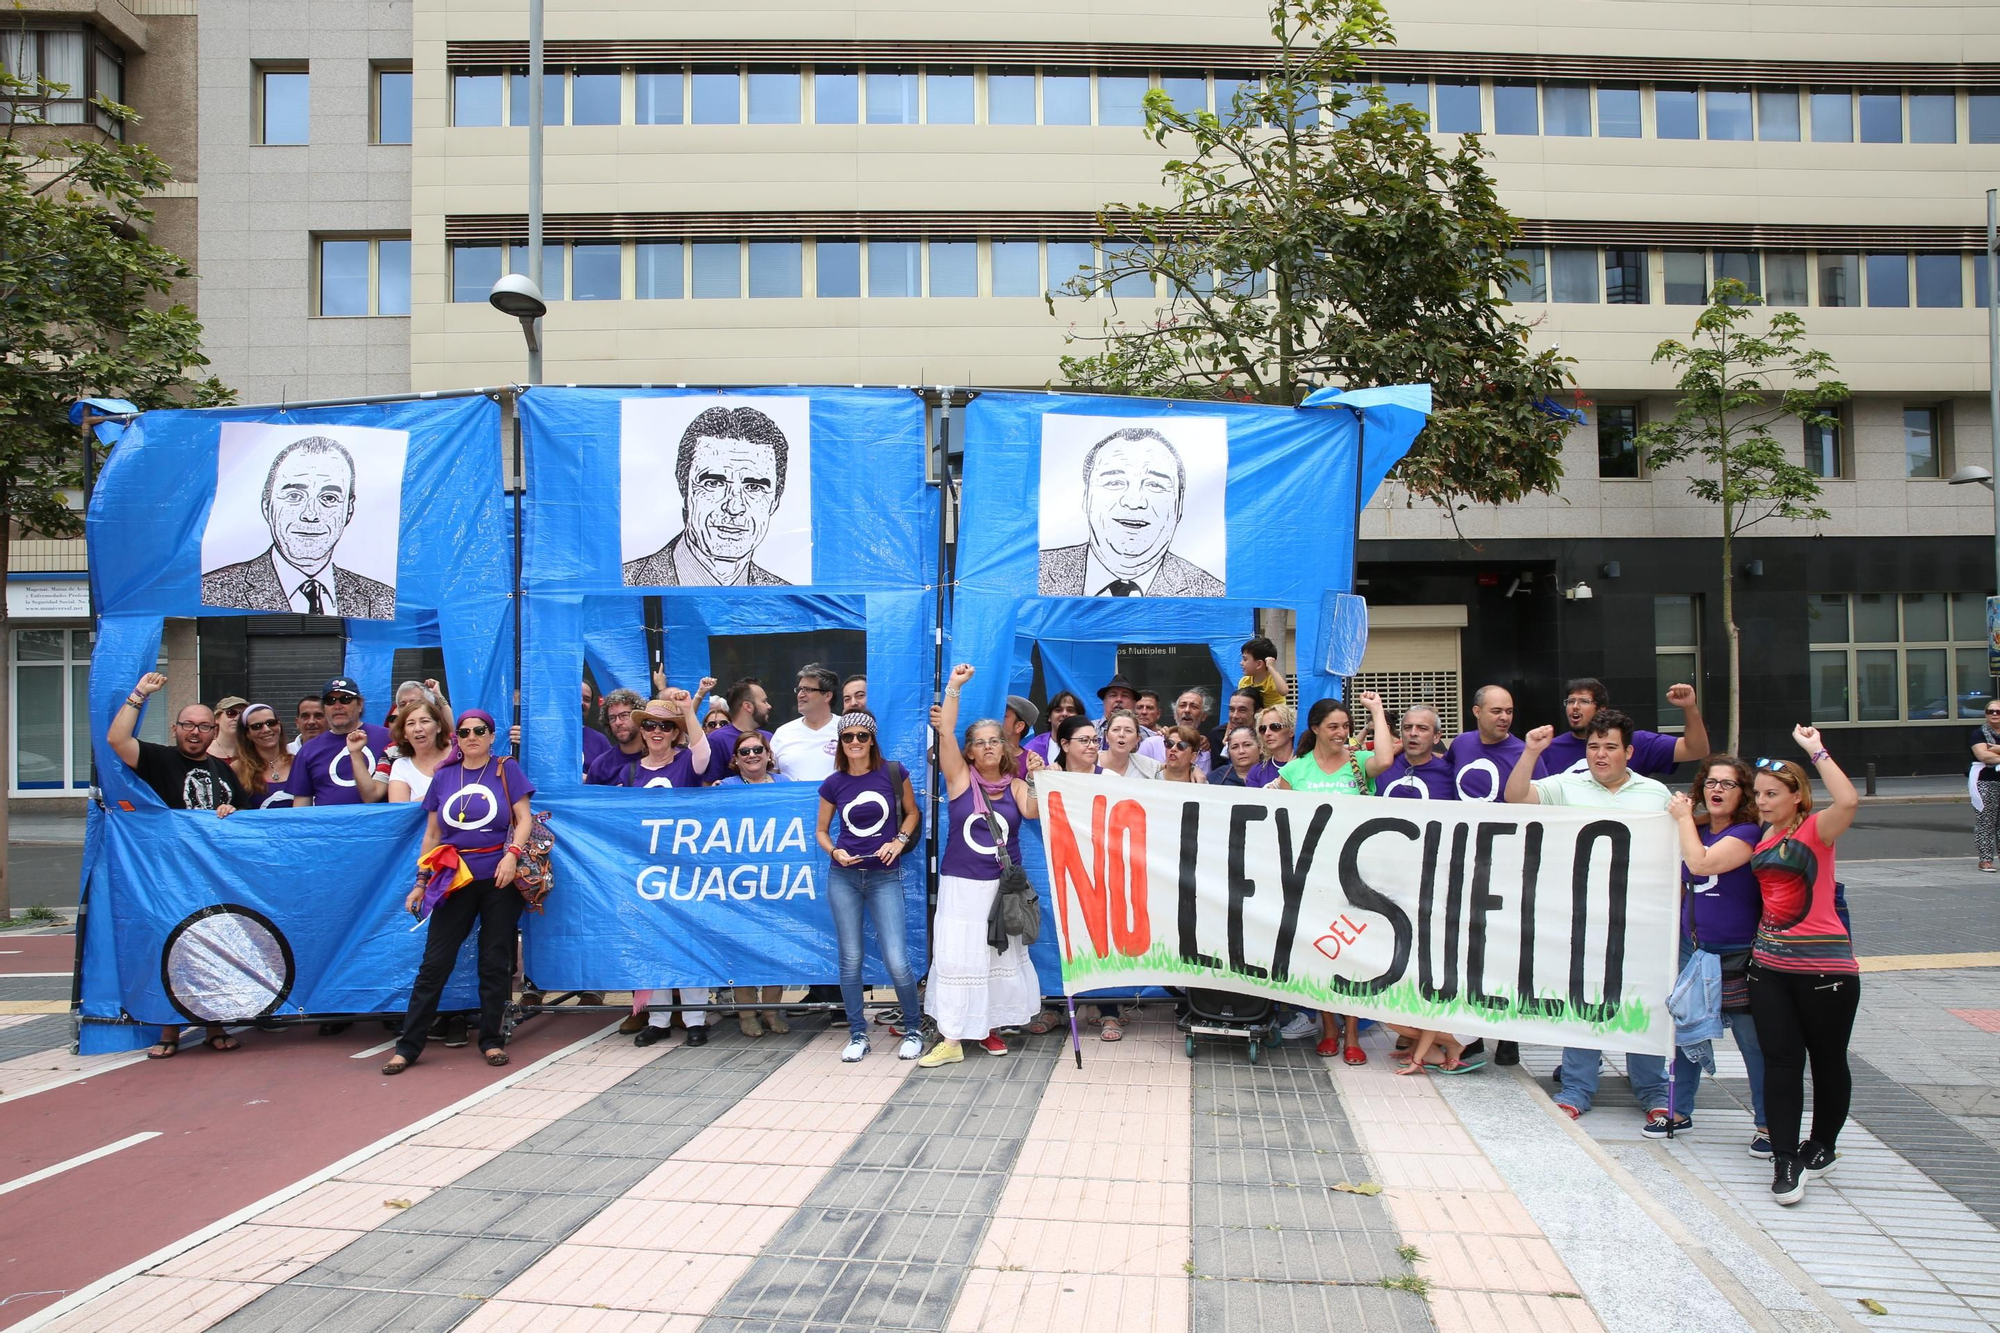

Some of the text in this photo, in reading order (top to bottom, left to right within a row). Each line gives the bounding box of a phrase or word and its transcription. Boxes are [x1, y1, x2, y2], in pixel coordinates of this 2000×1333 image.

[1128, 647, 1166, 656] Multiples
[1168, 646, 1176, 654] III
[641, 817, 807, 854] TRAMA
[636, 864, 816, 901] GUAGUA
[1049, 791, 1631, 1021] NO LEY DEL SUELO
